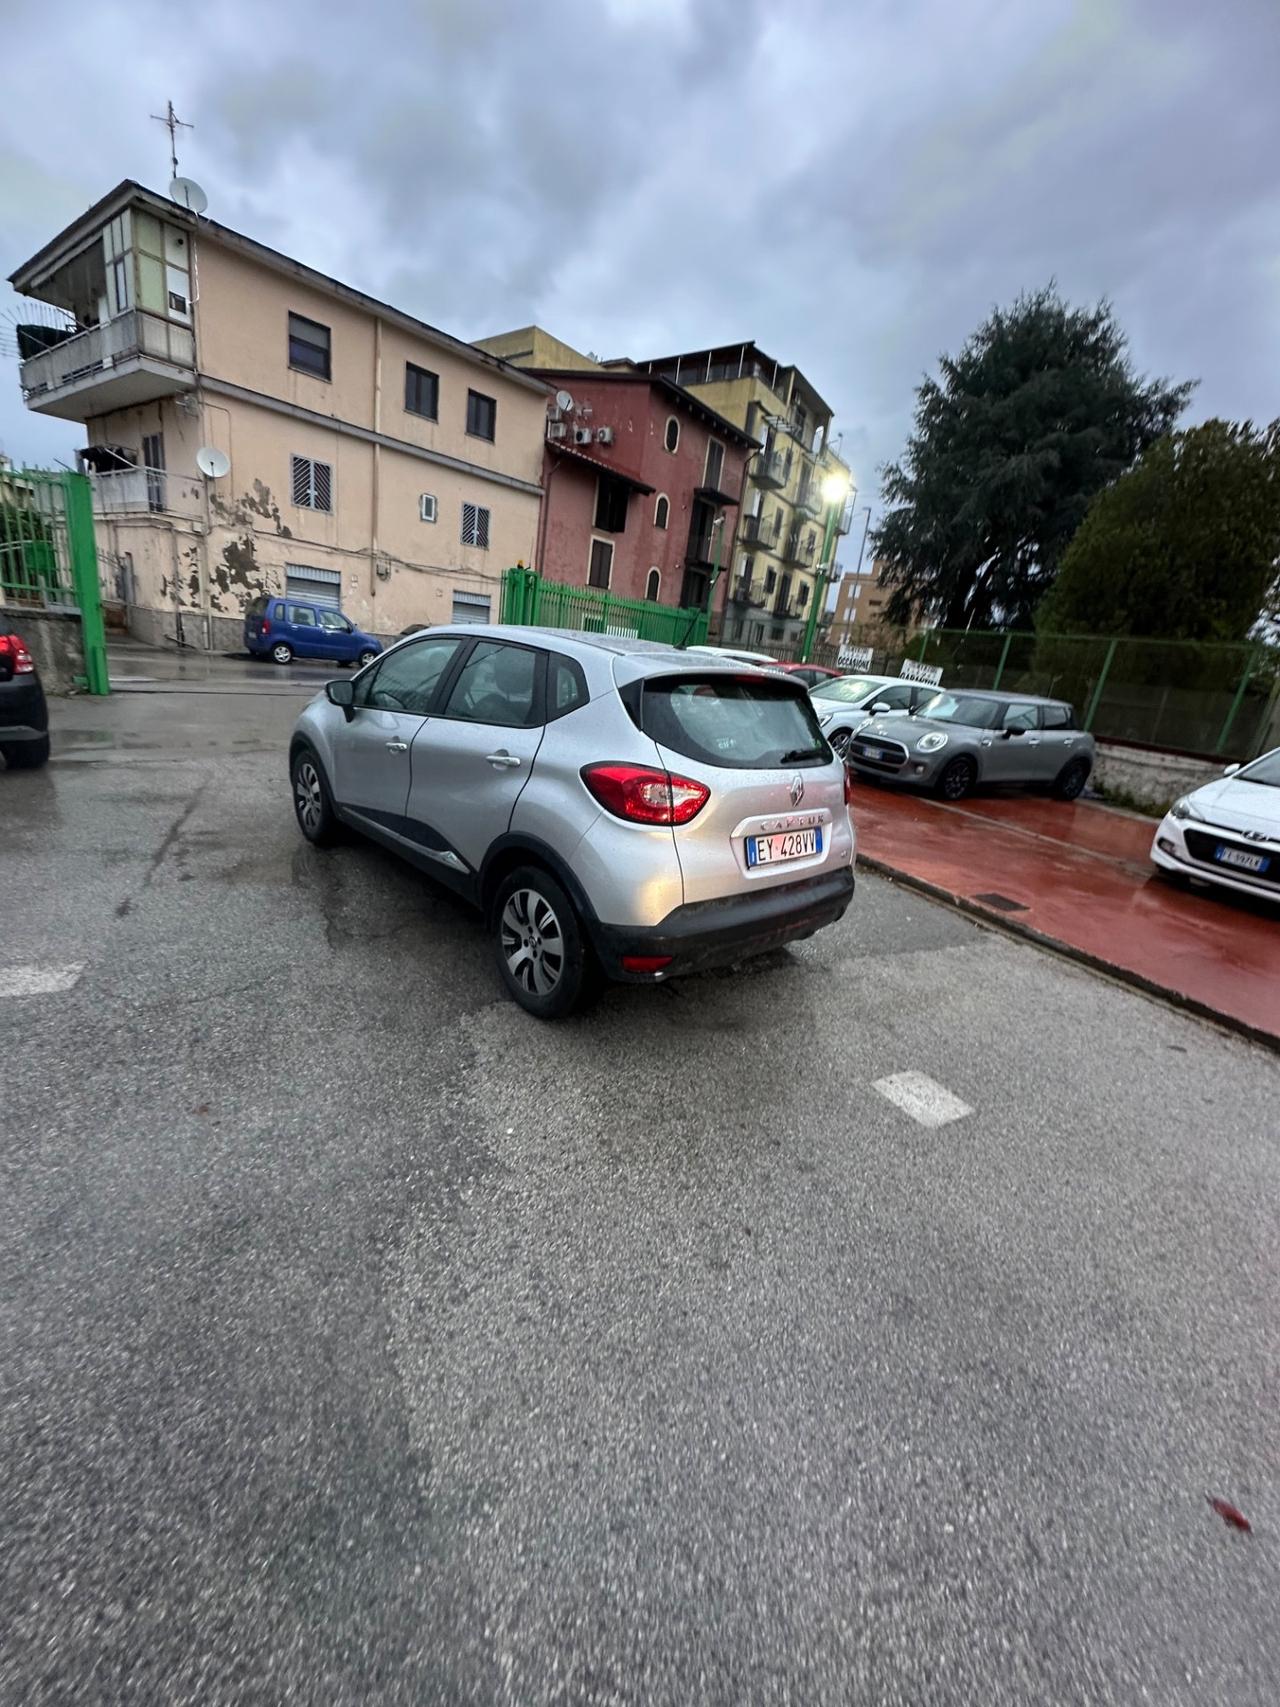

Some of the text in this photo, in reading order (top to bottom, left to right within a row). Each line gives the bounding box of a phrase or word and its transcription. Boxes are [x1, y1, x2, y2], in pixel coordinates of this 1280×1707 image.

[760, 816, 825, 831] CAPTUR
[757, 831, 815, 862] EY 428VV
